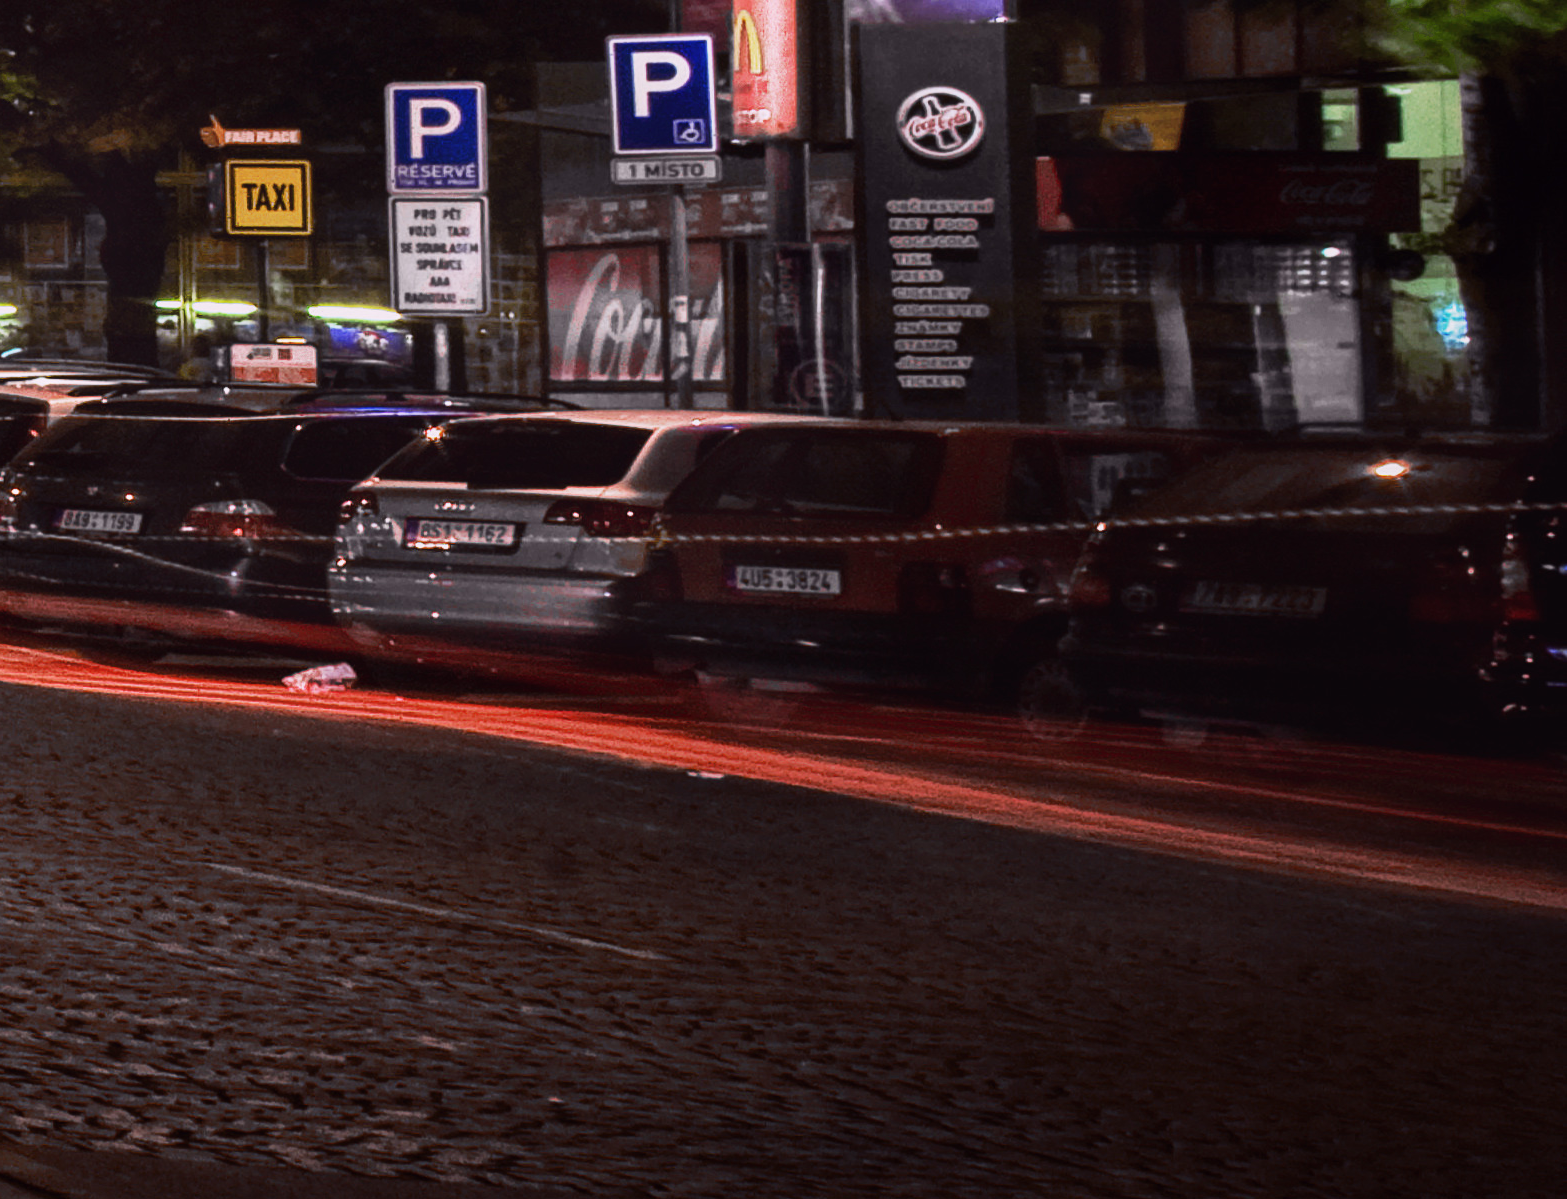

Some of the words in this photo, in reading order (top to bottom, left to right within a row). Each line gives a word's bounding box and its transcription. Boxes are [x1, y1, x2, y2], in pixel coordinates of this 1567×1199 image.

[631, 51, 691, 118] P
[410, 98, 461, 159] P
[397, 162, 477, 178] RÉSERVÉ
[629, 164, 637, 178] 1
[644, 161, 706, 178] MÍSTO
[241, 183, 294, 211] TAXI
[889, 217, 929, 231] FAST
[933, 217, 979, 231] FOOD
